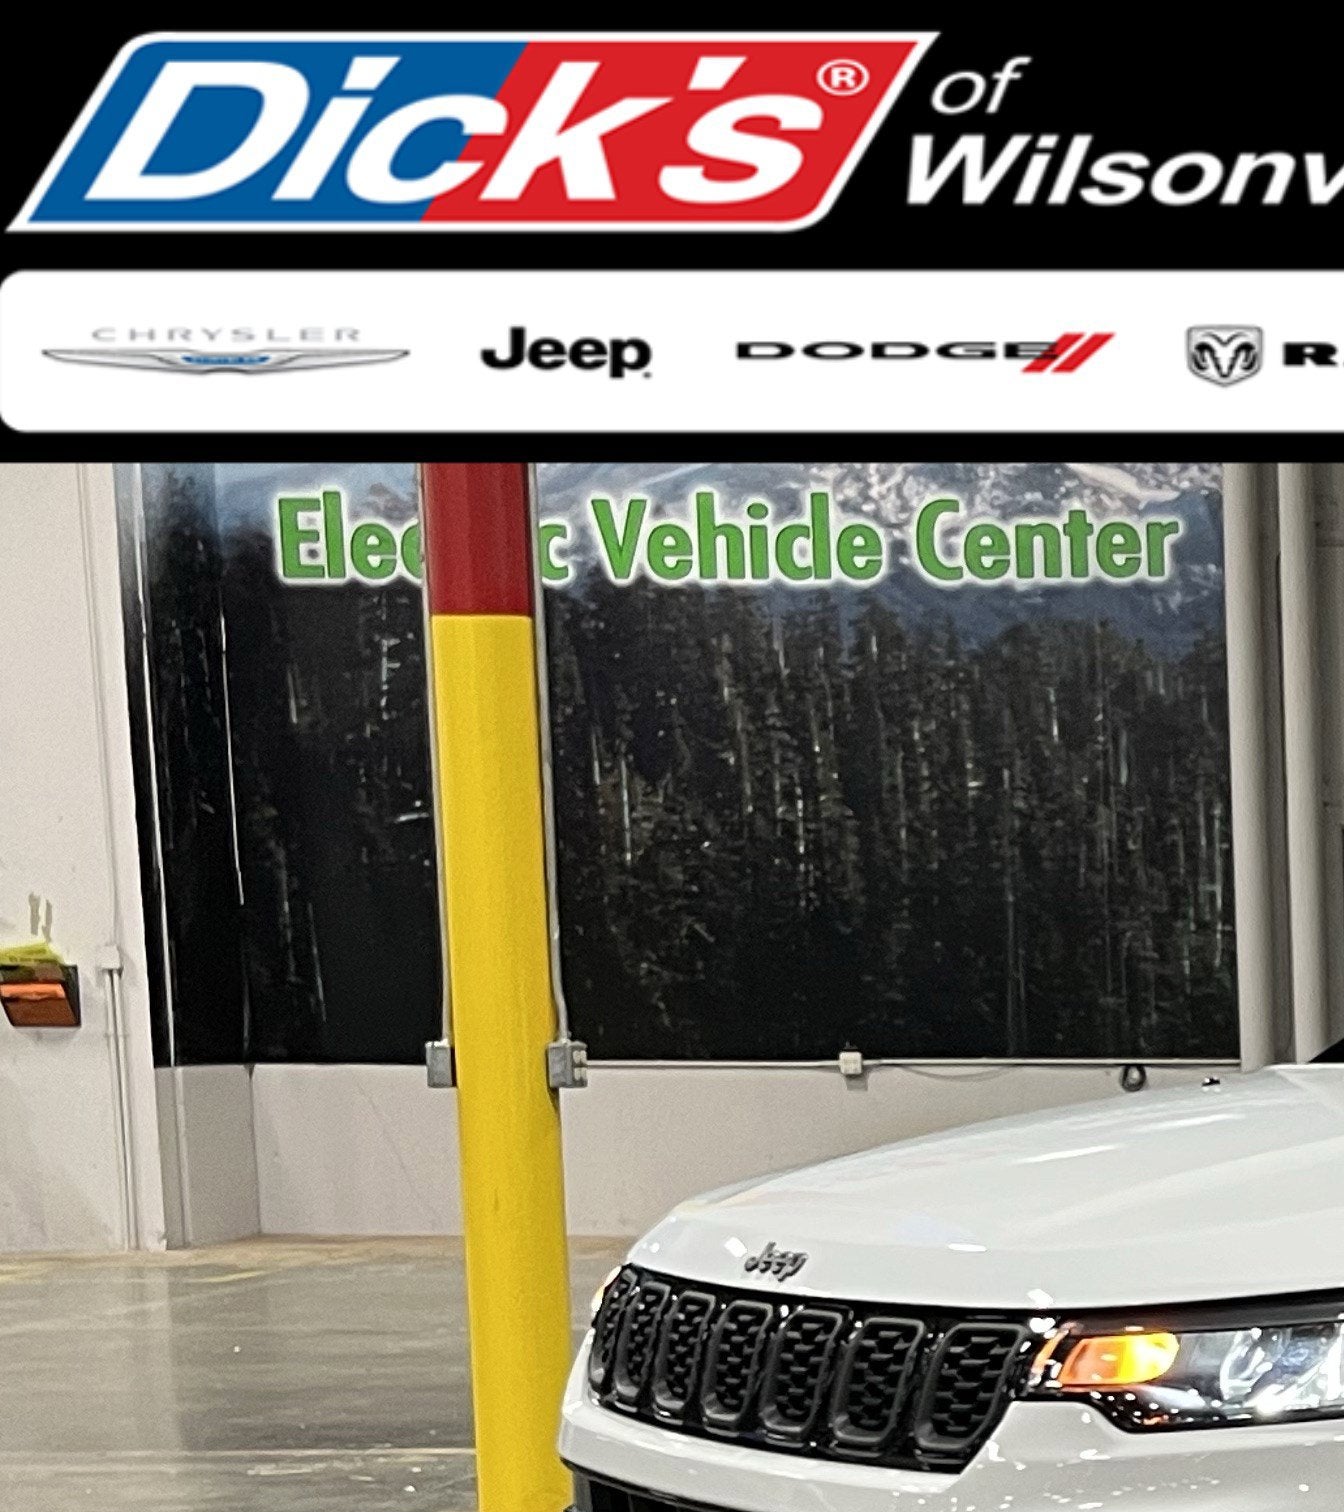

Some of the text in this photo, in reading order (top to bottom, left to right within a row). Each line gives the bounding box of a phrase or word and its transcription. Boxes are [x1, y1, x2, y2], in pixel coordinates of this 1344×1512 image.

[590, 491, 883, 581] Vehicle
[915, 498, 1180, 580] Center
[744, 1241, 808, 1282] Jeep
